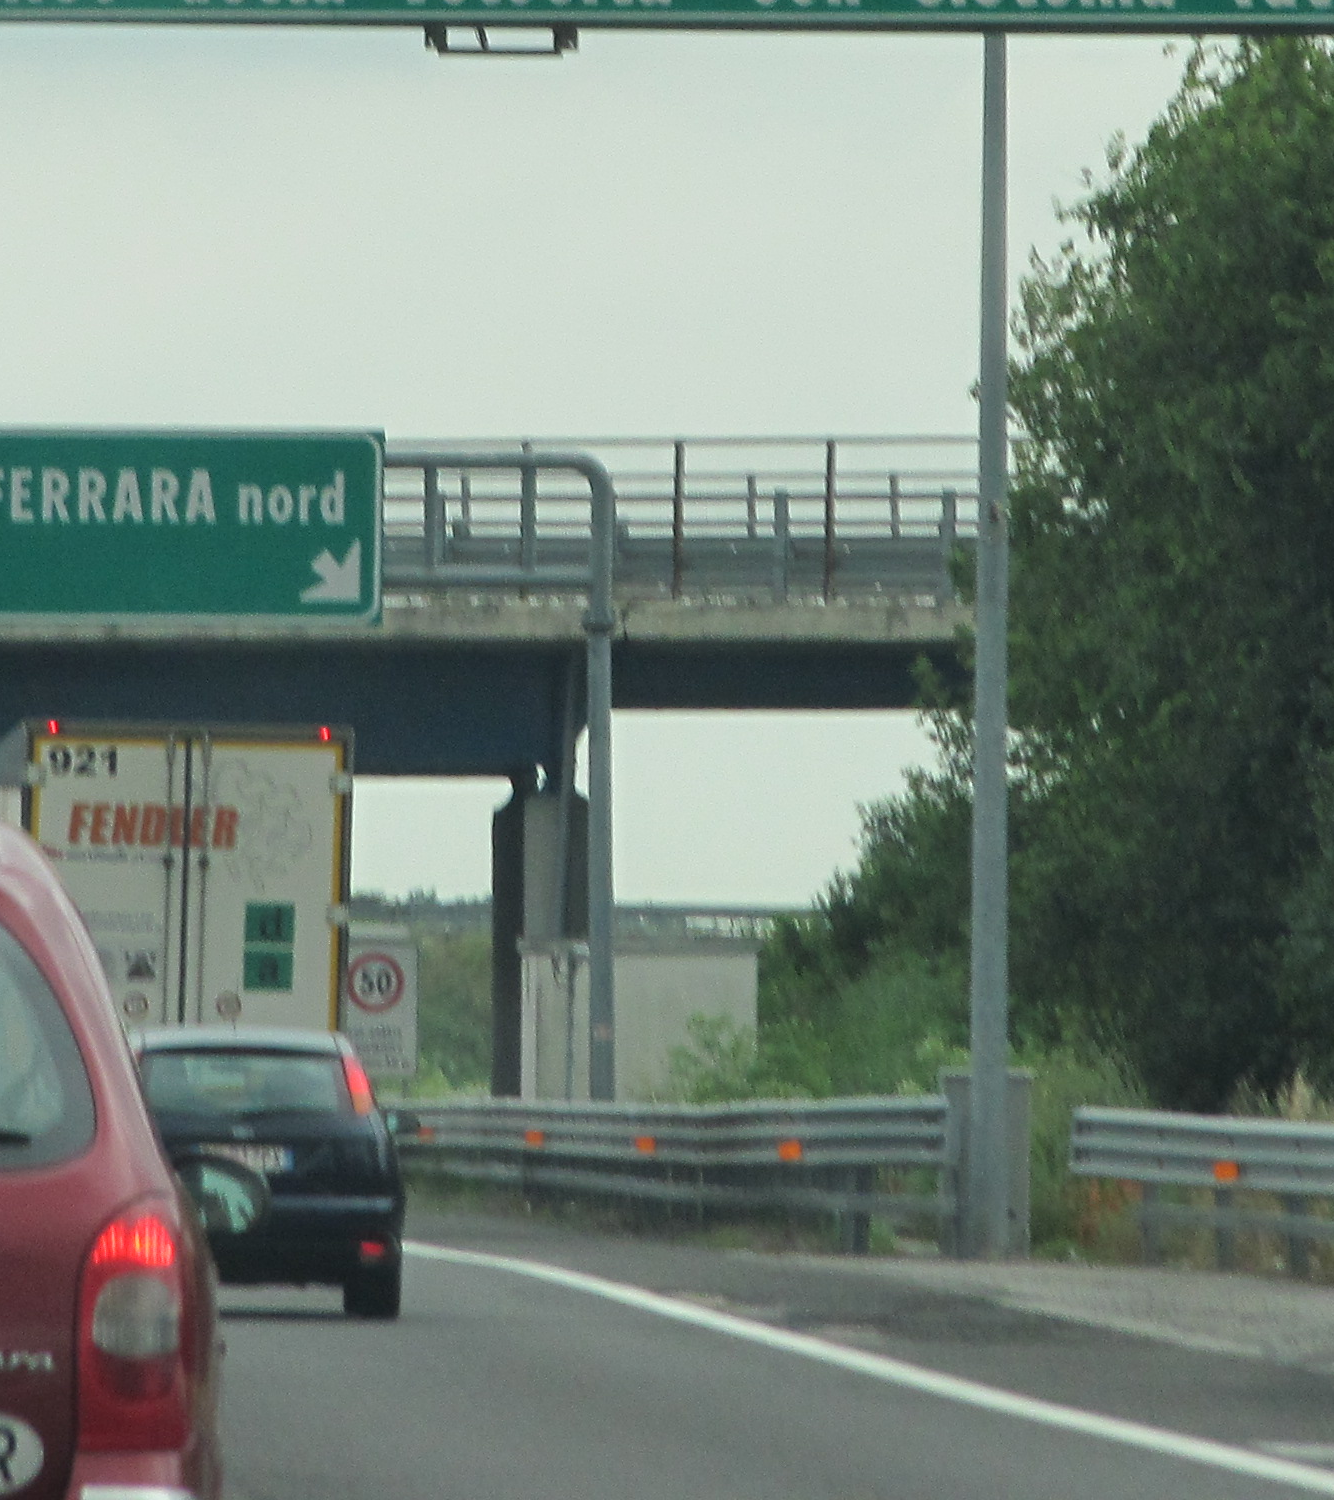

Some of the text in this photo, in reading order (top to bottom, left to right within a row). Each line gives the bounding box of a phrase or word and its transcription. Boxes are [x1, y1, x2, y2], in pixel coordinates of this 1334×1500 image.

[238, 471, 346, 526] nord
[48, 746, 118, 778] 921
[68, 802, 239, 850] FENDLER
